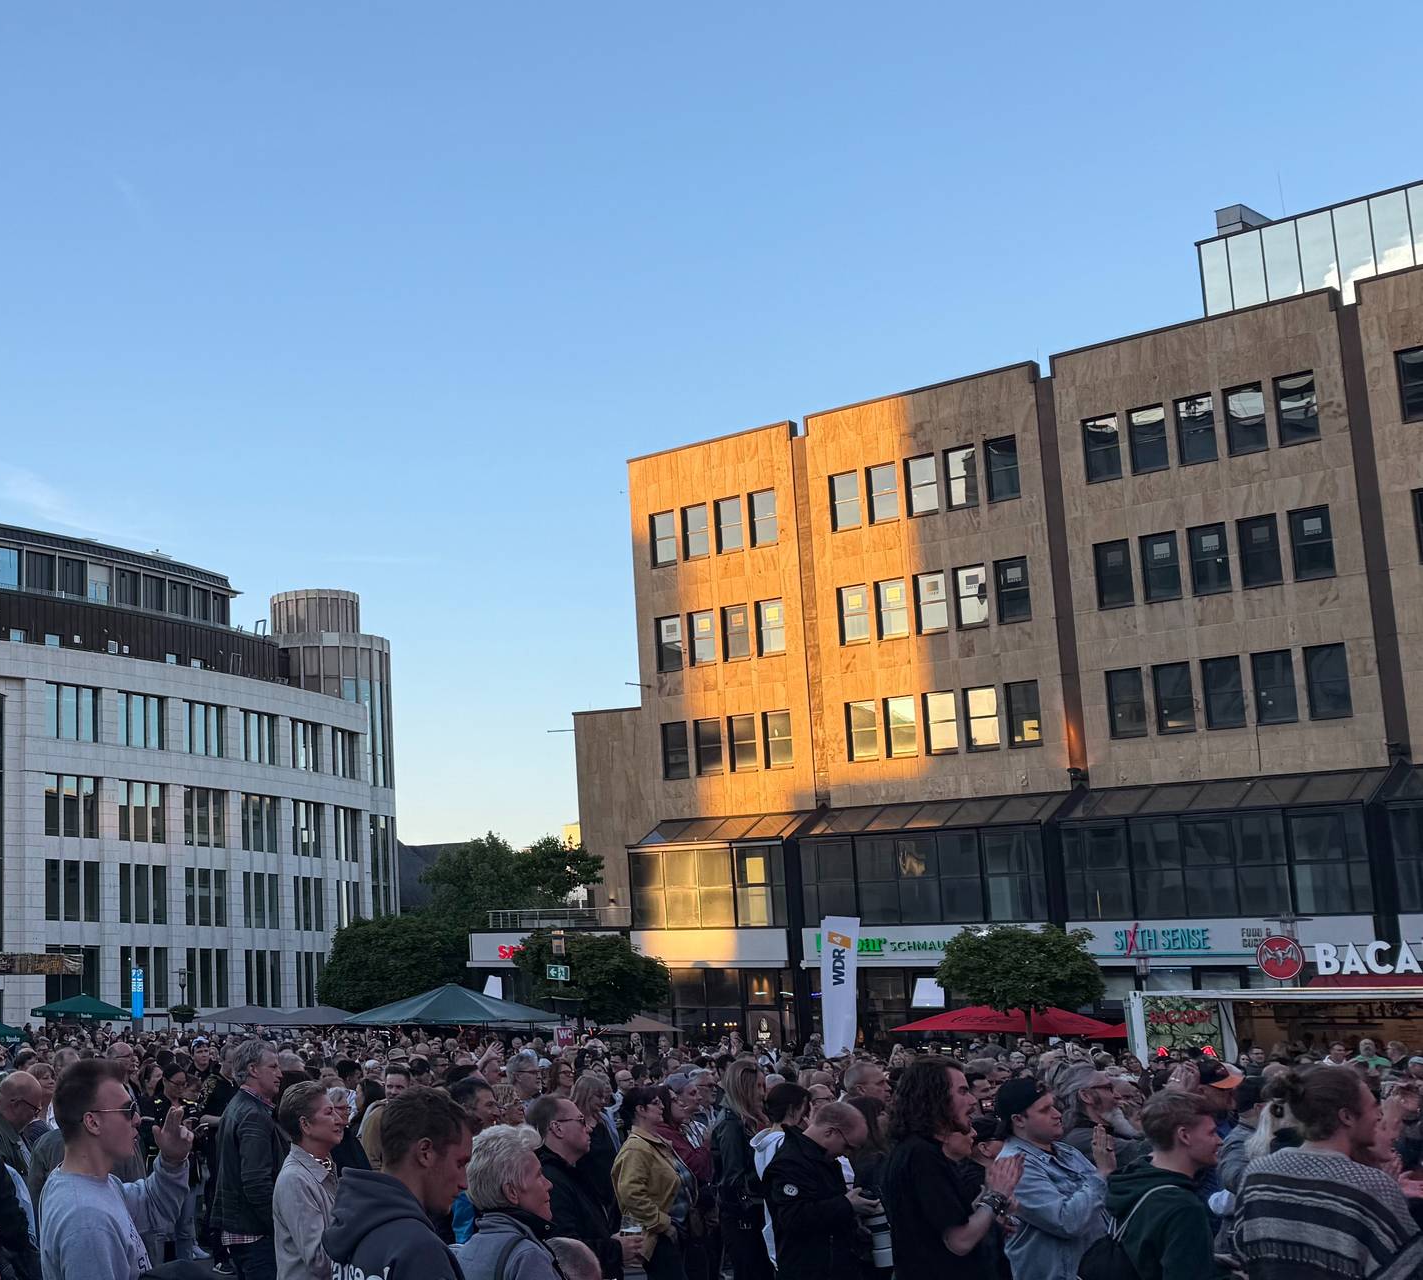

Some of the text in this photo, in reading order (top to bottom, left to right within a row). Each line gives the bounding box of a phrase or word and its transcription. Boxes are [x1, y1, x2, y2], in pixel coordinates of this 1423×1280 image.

[890, 940, 951, 952] SCHMAU
[1114, 922, 1211, 958] SIXTH SENSE
[832, 948, 846, 987] WDR
[1315, 939, 1423, 976] BACA
[1148, 1009, 1212, 1025] BACARDI
[558, 1029, 573, 1039] WC
